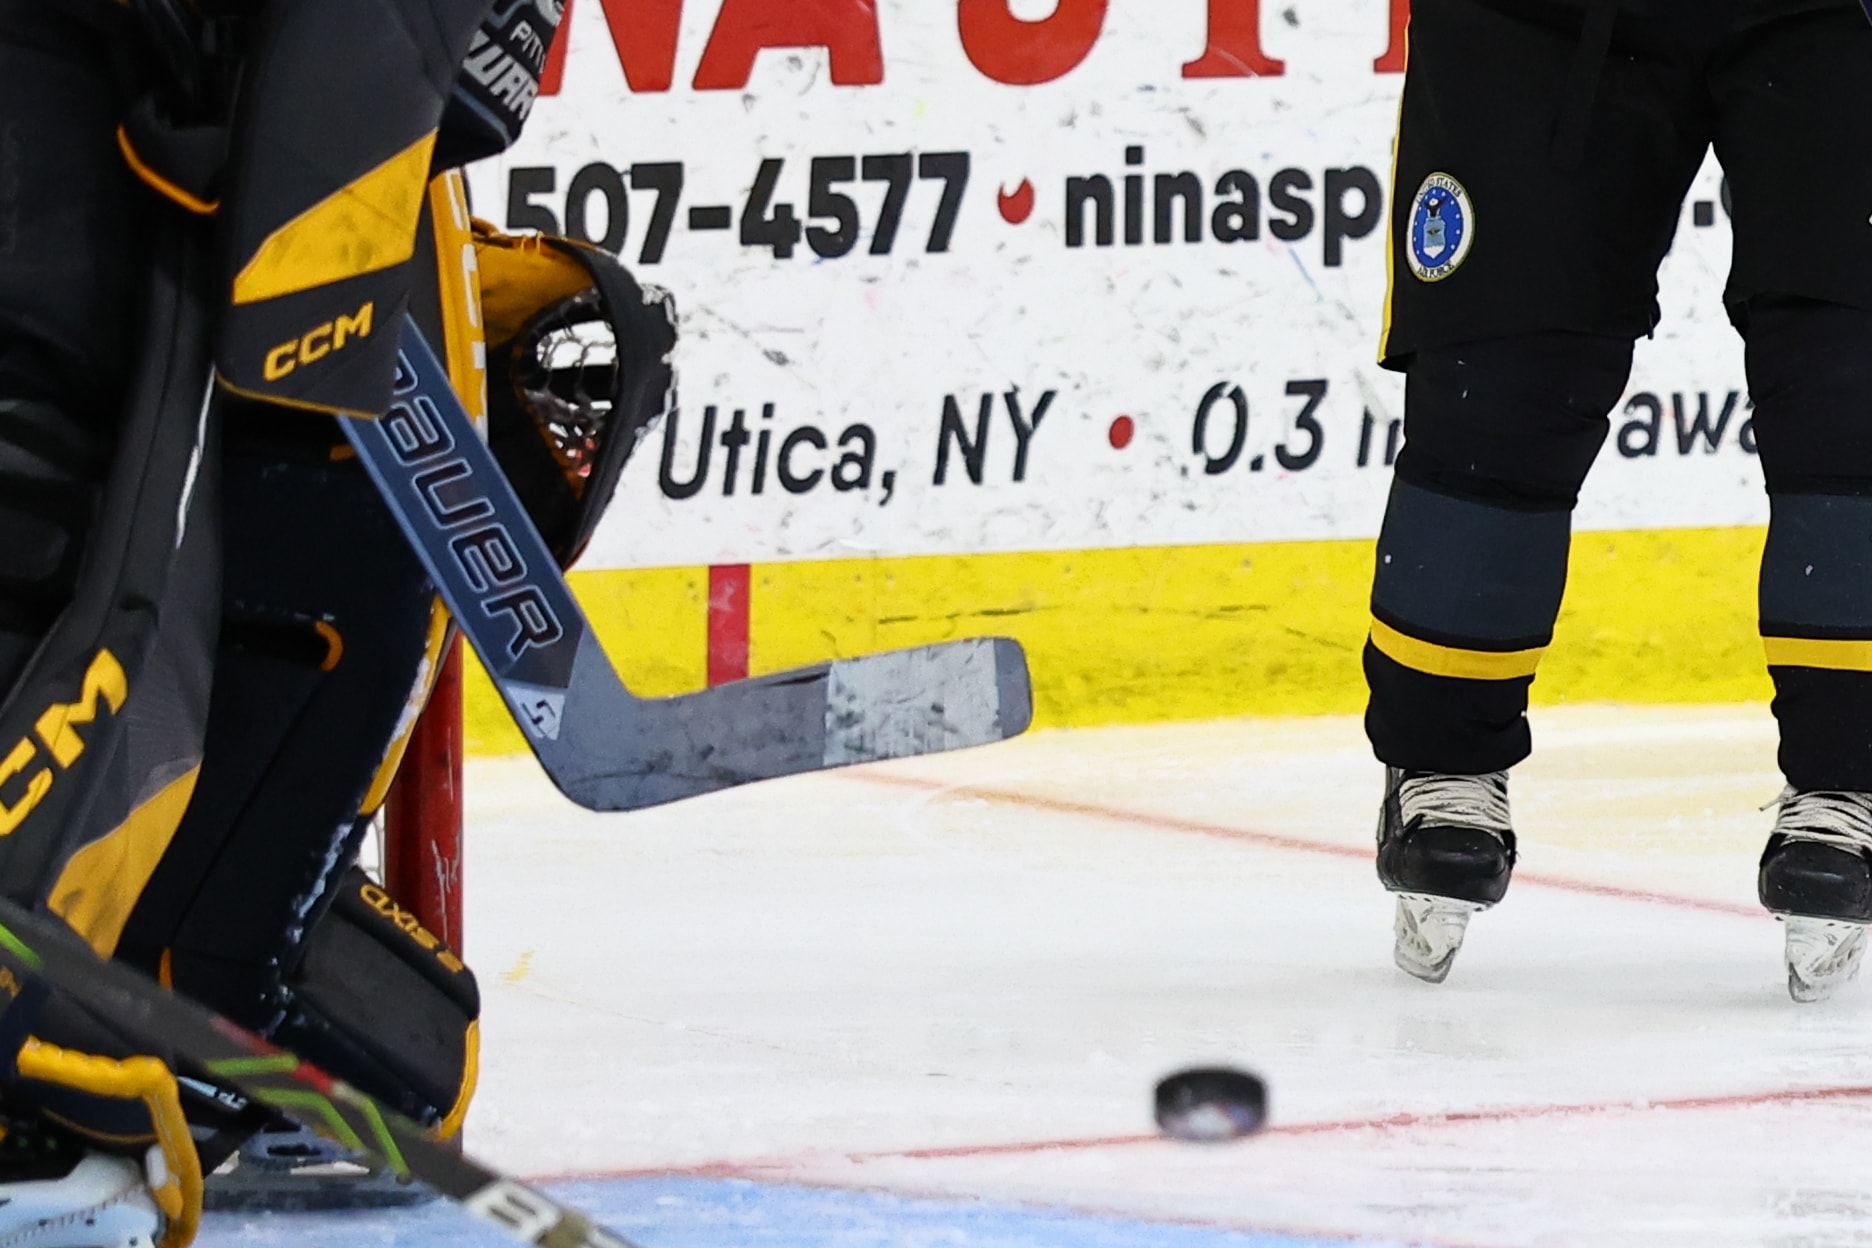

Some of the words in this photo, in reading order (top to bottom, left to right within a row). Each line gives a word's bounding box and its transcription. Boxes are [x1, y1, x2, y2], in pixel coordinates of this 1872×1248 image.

[262, 300, 374, 383] CCM
[657, 401, 897, 507] Utica,
[931, 391, 1057, 487] NY
[1191, 377, 1329, 477] 0.3
